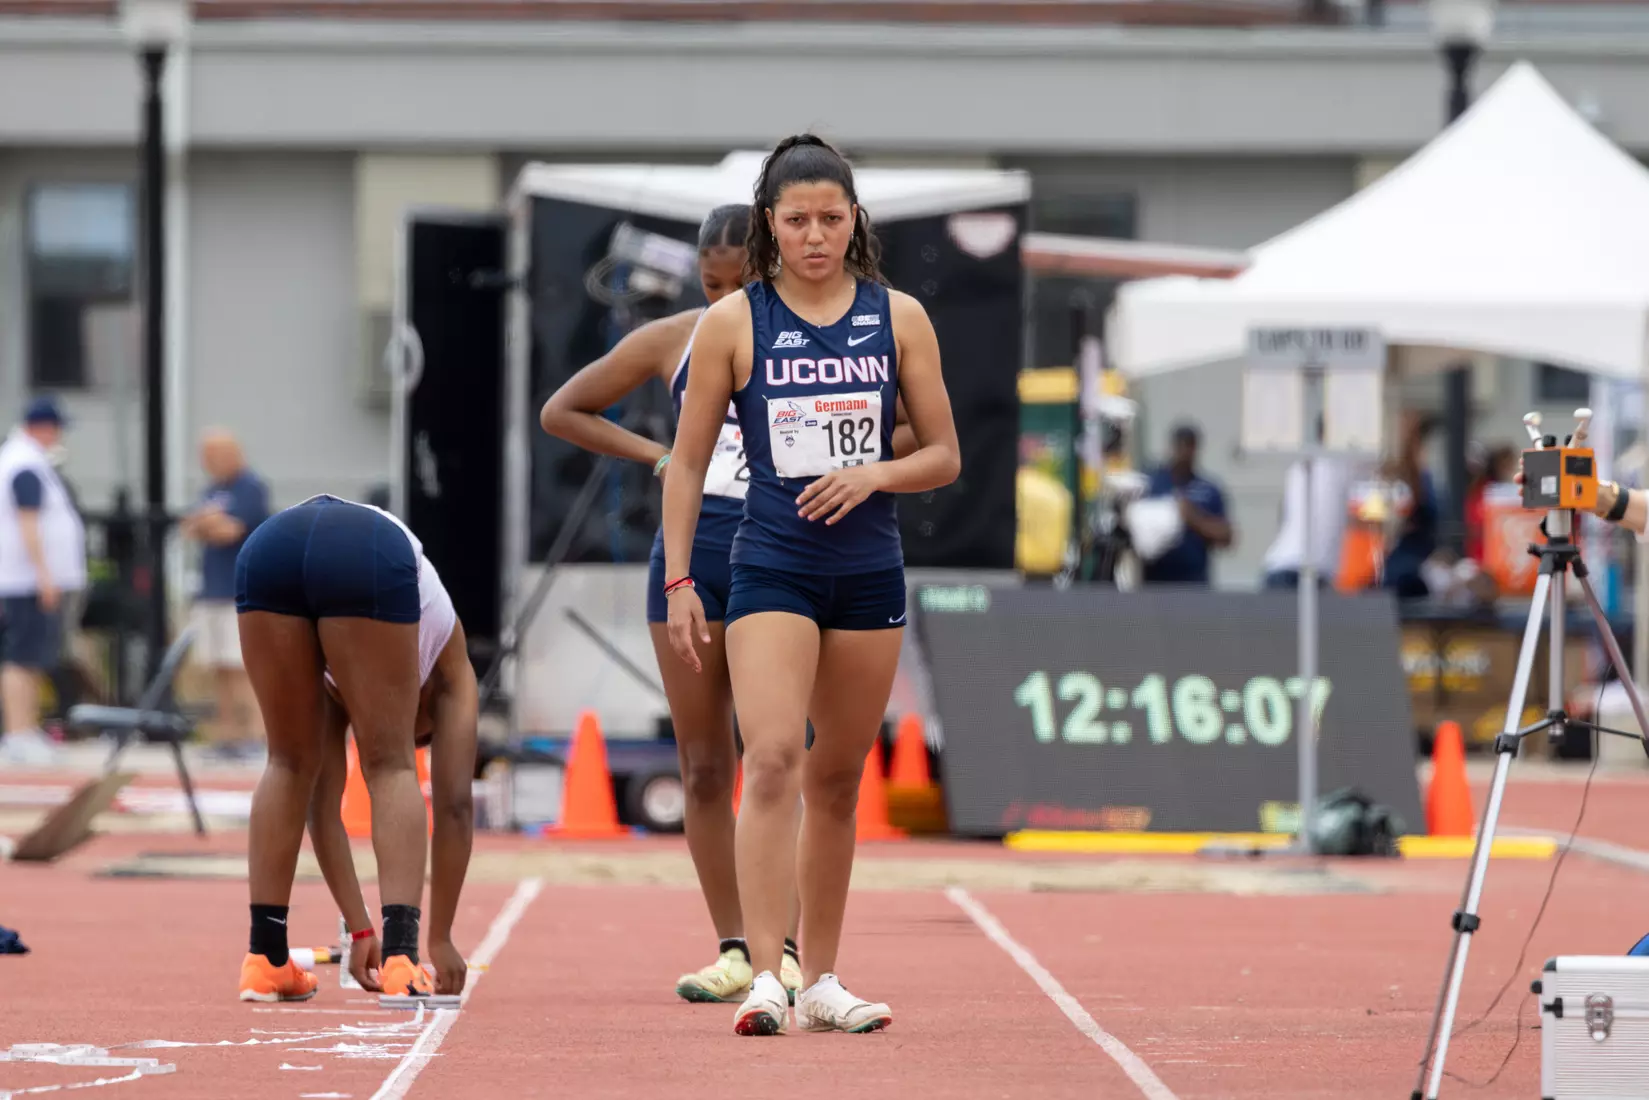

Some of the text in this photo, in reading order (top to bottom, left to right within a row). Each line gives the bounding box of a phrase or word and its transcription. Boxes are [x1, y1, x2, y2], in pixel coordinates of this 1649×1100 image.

[778, 331, 803, 339] BIG
[774, 338, 810, 346] EAST
[765, 355, 889, 386] UCONN
[815, 400, 867, 412] Germann
[776, 410, 797, 418] BIG
[773, 416, 803, 424] EAST
[822, 417, 875, 457] 182
[1014, 670, 1331, 745] 12:16:07
